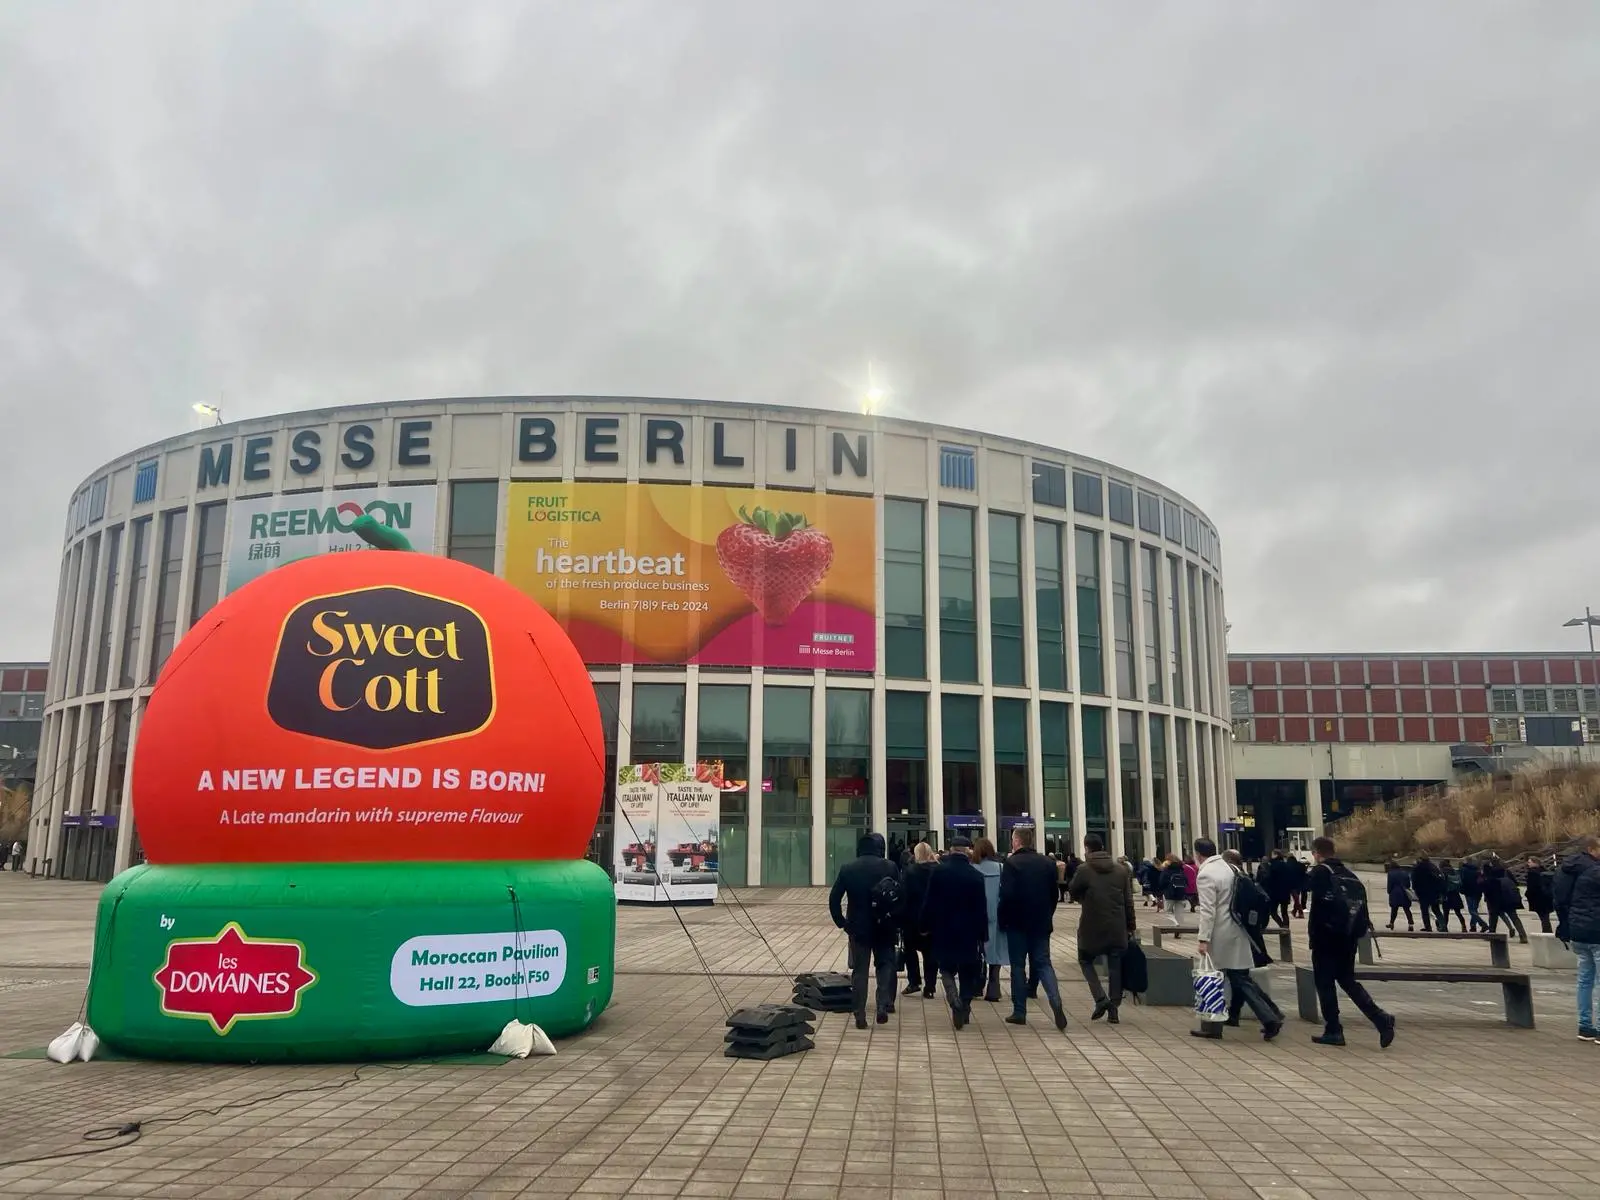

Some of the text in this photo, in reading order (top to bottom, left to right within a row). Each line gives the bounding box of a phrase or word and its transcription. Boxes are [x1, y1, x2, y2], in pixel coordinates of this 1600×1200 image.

[197, 417, 868, 489] MESSE BERLIN
[528, 496, 568, 508] FRUIT
[249, 500, 412, 539] REEMOON
[527, 509, 601, 522] LOGISTICA
[548, 537, 569, 548] The
[536, 548, 685, 576] heartbeat
[545, 578, 710, 591] of the fresh produce business
[600, 600, 630, 610] Berlin
[661, 601, 679, 611] Feb
[682, 601, 709, 612] 2024
[306, 610, 464, 661] Sweet
[814, 634, 853, 642] FRUITNET
[812, 647, 855, 656] Messe Berlin
[318, 658, 446, 714] Cott
[198, 767, 546, 793] A NEW LEGEND IS BORN!
[622, 793, 653, 802] ITALIAN WAY
[666, 793, 713, 802] ITALIAN WAY
[220, 807, 523, 826] A Late mandarin with supreme Flavour
[160, 914, 175, 930] by
[218, 953, 238, 969] les
[411, 943, 559, 967] Moroccan Pavilion
[169, 970, 291, 995] DOMAINES
[419, 970, 550, 992] Hall 22, Booth F50
